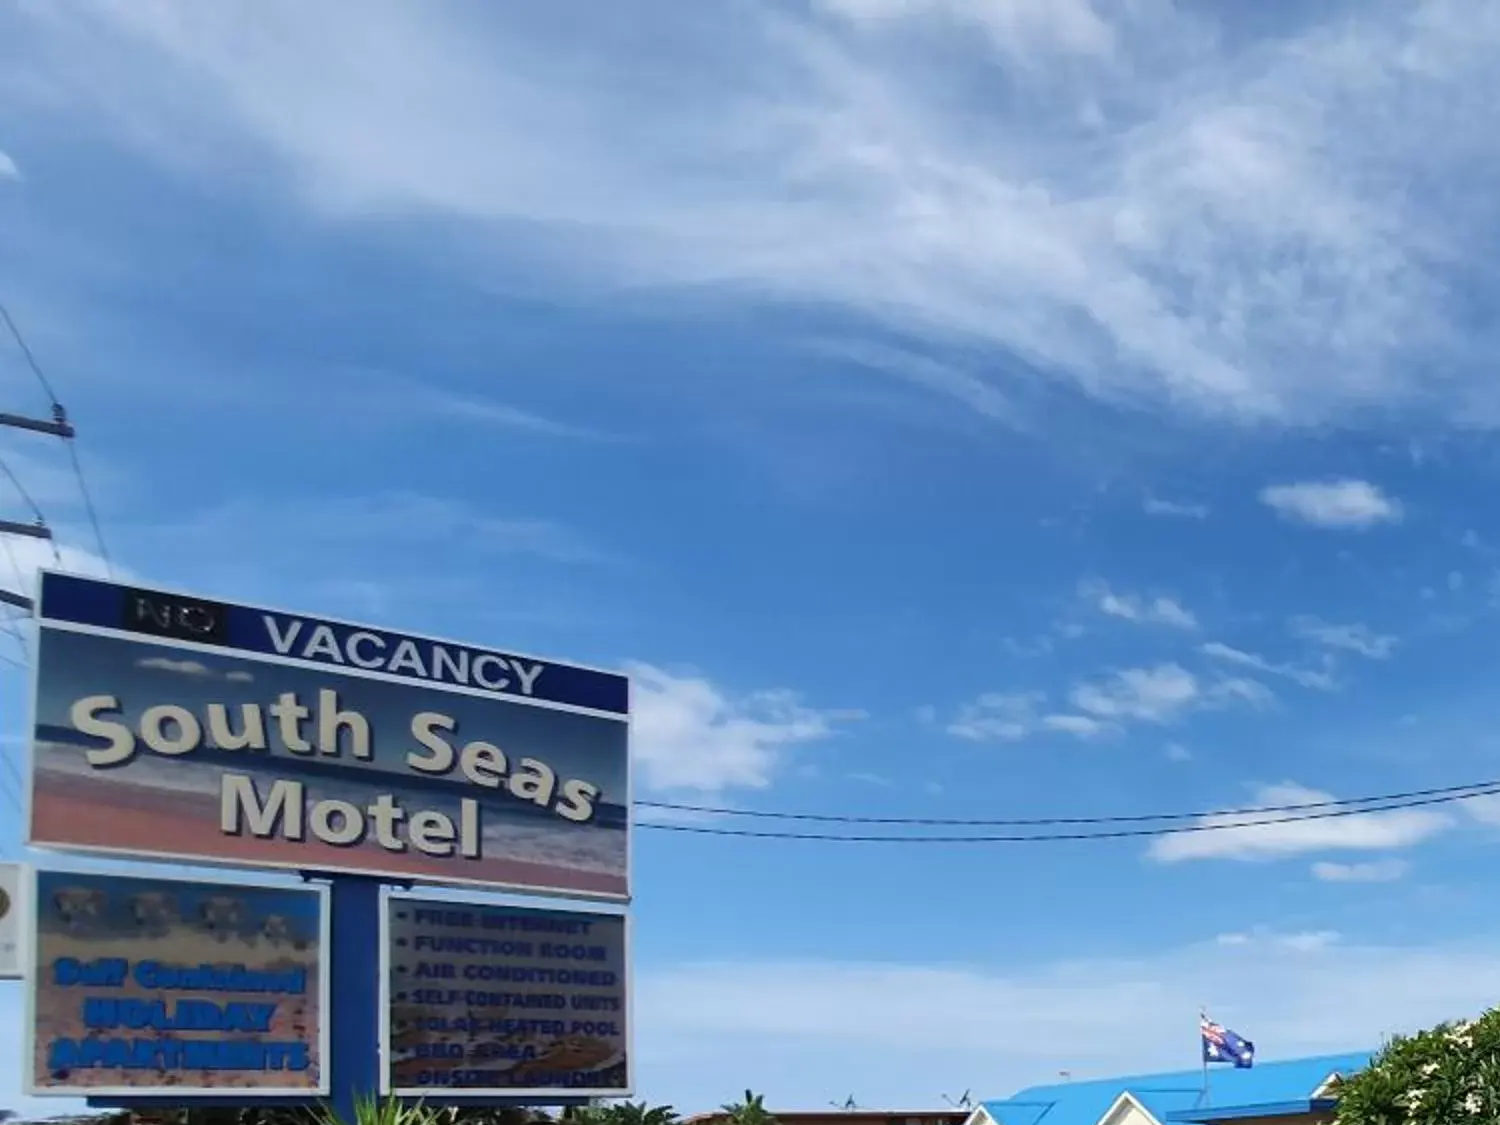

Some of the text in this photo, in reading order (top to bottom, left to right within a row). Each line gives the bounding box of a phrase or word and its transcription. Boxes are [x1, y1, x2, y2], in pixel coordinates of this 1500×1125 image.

[263, 615, 544, 694] VACANCY
[70, 688, 601, 823] South Seas
[220, 774, 482, 859] Motel
[414, 909, 473, 928] FREE
[414, 936, 607, 961] FUNCTION ROOM
[414, 961, 617, 986] AIR CONDITIONED
[412, 989, 621, 1011] SELF CONTAINED UNITS
[489, 1019, 565, 1036] HEATED
[571, 1020, 620, 1037] POOL
